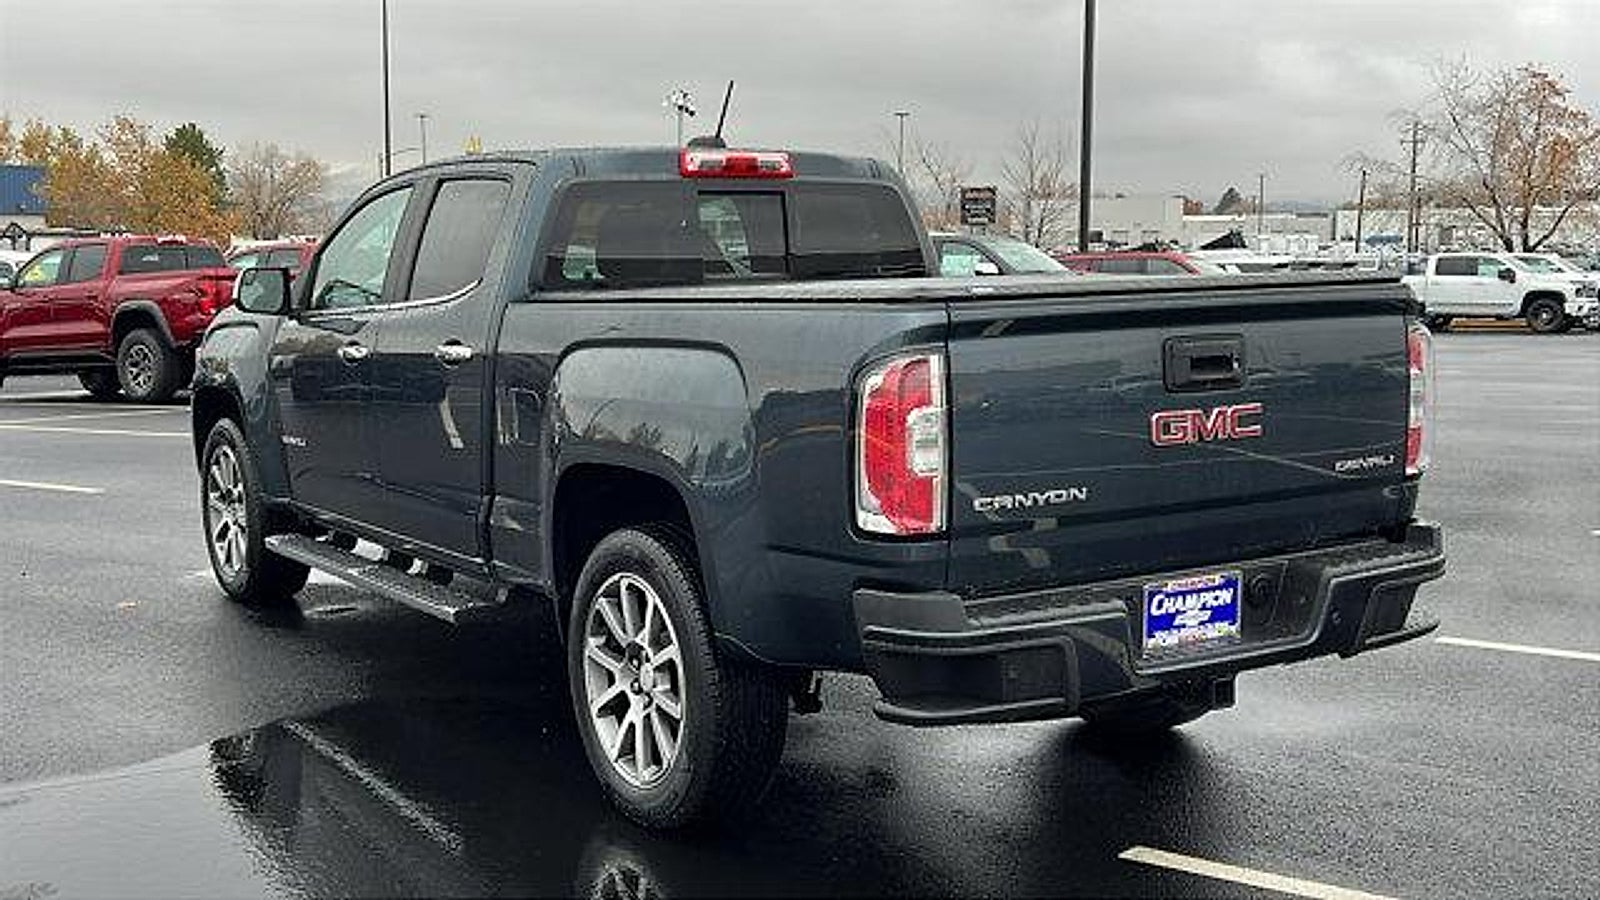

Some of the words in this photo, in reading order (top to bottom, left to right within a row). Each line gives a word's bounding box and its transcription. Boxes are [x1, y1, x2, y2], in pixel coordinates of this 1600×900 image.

[1152, 403, 1263, 446] GMC
[974, 487, 1087, 511] CANYON
[1150, 588, 1234, 616] CHAMPION
